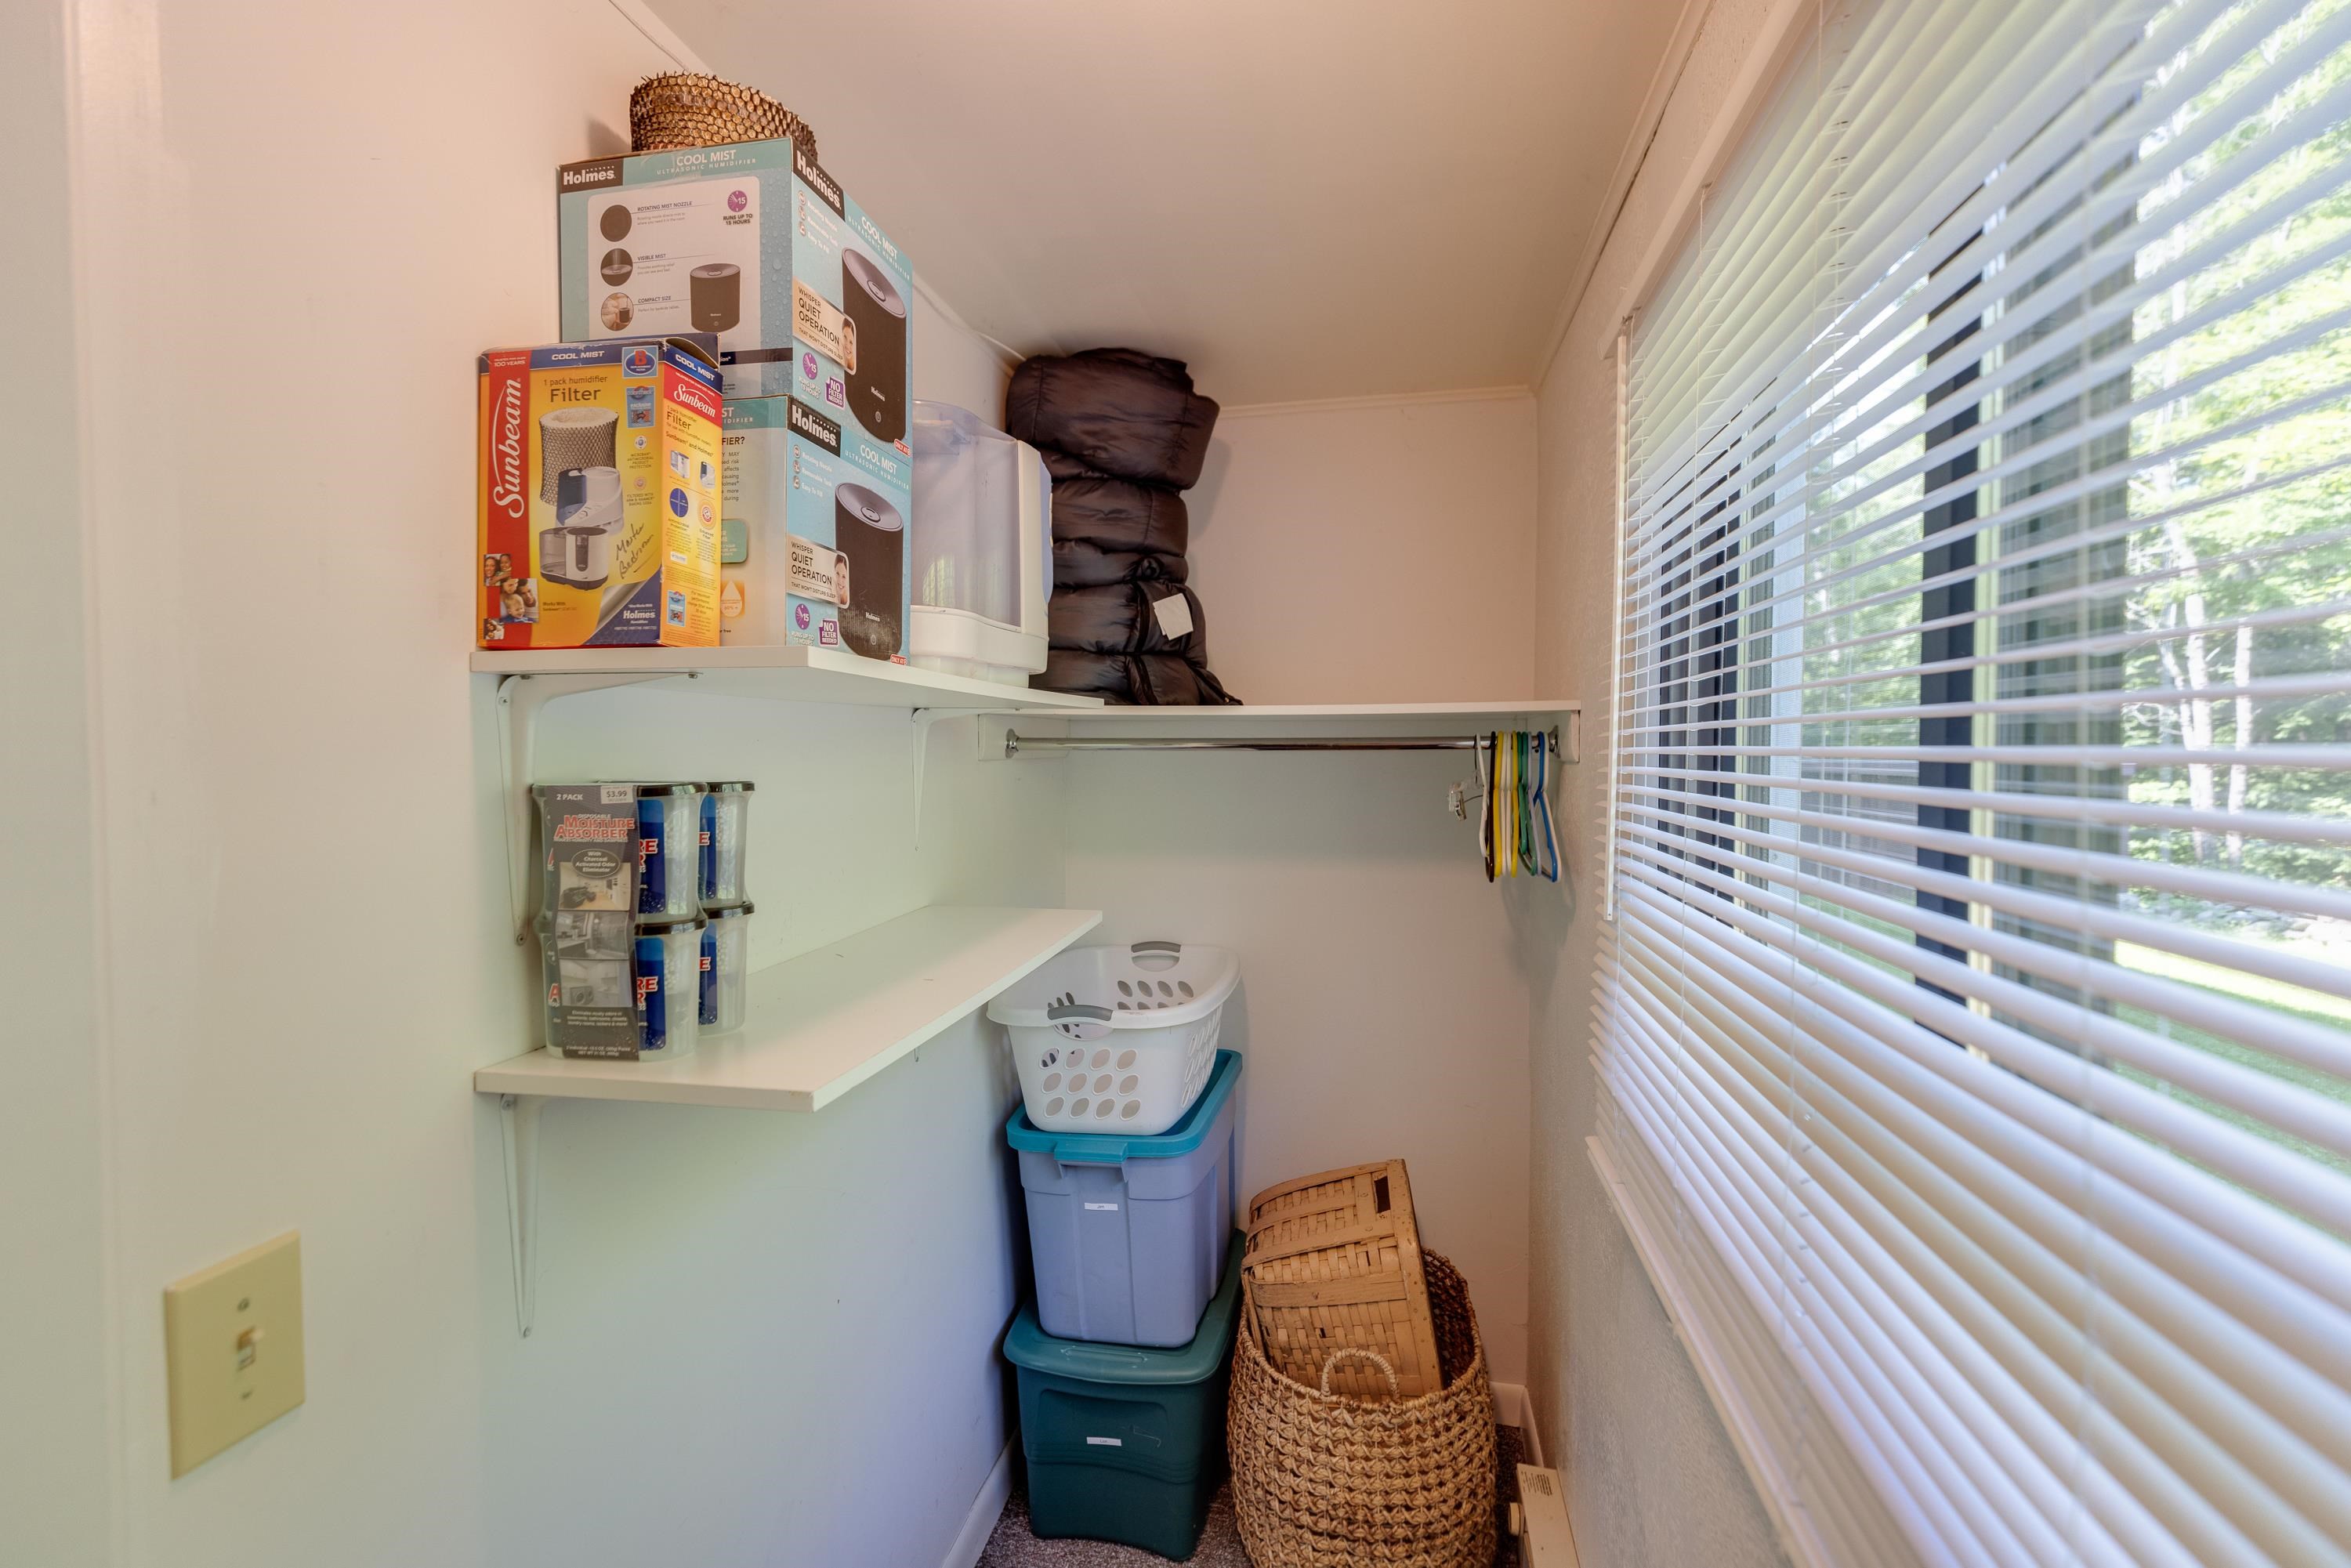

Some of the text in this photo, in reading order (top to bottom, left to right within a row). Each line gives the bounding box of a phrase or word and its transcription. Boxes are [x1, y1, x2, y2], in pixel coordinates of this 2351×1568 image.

[676, 150, 737, 166] COOL MIST
[657, 158, 756, 176] ULTRASONIC HUMIDIFIER
[563, 169, 615, 186] Holmes
[796, 150, 842, 211] Holmes
[861, 215, 897, 260] COOL MIST
[798, 287, 821, 308] WHISPER
[799, 297, 821, 320] QUIET
[799, 310, 840, 346] OPERATION
[580, 350, 605, 359] MIST
[635, 350, 647, 365] B
[675, 353, 715, 382] COOL MIST
[810, 363, 817, 373] 15
[550, 378, 567, 387] pack
[569, 375, 608, 385] humidifier
[830, 379, 841, 393] NO
[550, 387, 601, 403] Filter
[674, 383, 715, 418] Sunbeam
[828, 388, 842, 400] FILTER
[828, 394, 843, 406] NEEDED
[667, 411, 692, 429] Filter
[722, 407, 734, 418] ST
[792, 404, 836, 447] Holmes
[493, 378, 525, 519] Sunbeam
[860, 444, 897, 475] COOL MIST
[845, 449, 909, 490] ULTRASONIC HUMIDIFIER
[616, 523, 644, 560] Master
[791, 541, 813, 555] WHISPER
[619, 534, 654, 580] Bedroom
[791, 551, 813, 567] QUIET
[791, 564, 832, 586] OPERATION
[813, 588, 826, 596] DISTURB
[623, 610, 657, 619] Holmes
[802, 613, 810, 622] 15
[865, 611, 880, 622] Holmes
[823, 621, 835, 632] NO
[564, 814, 635, 829] MOISTURE
[554, 824, 629, 840] ABSORBER
